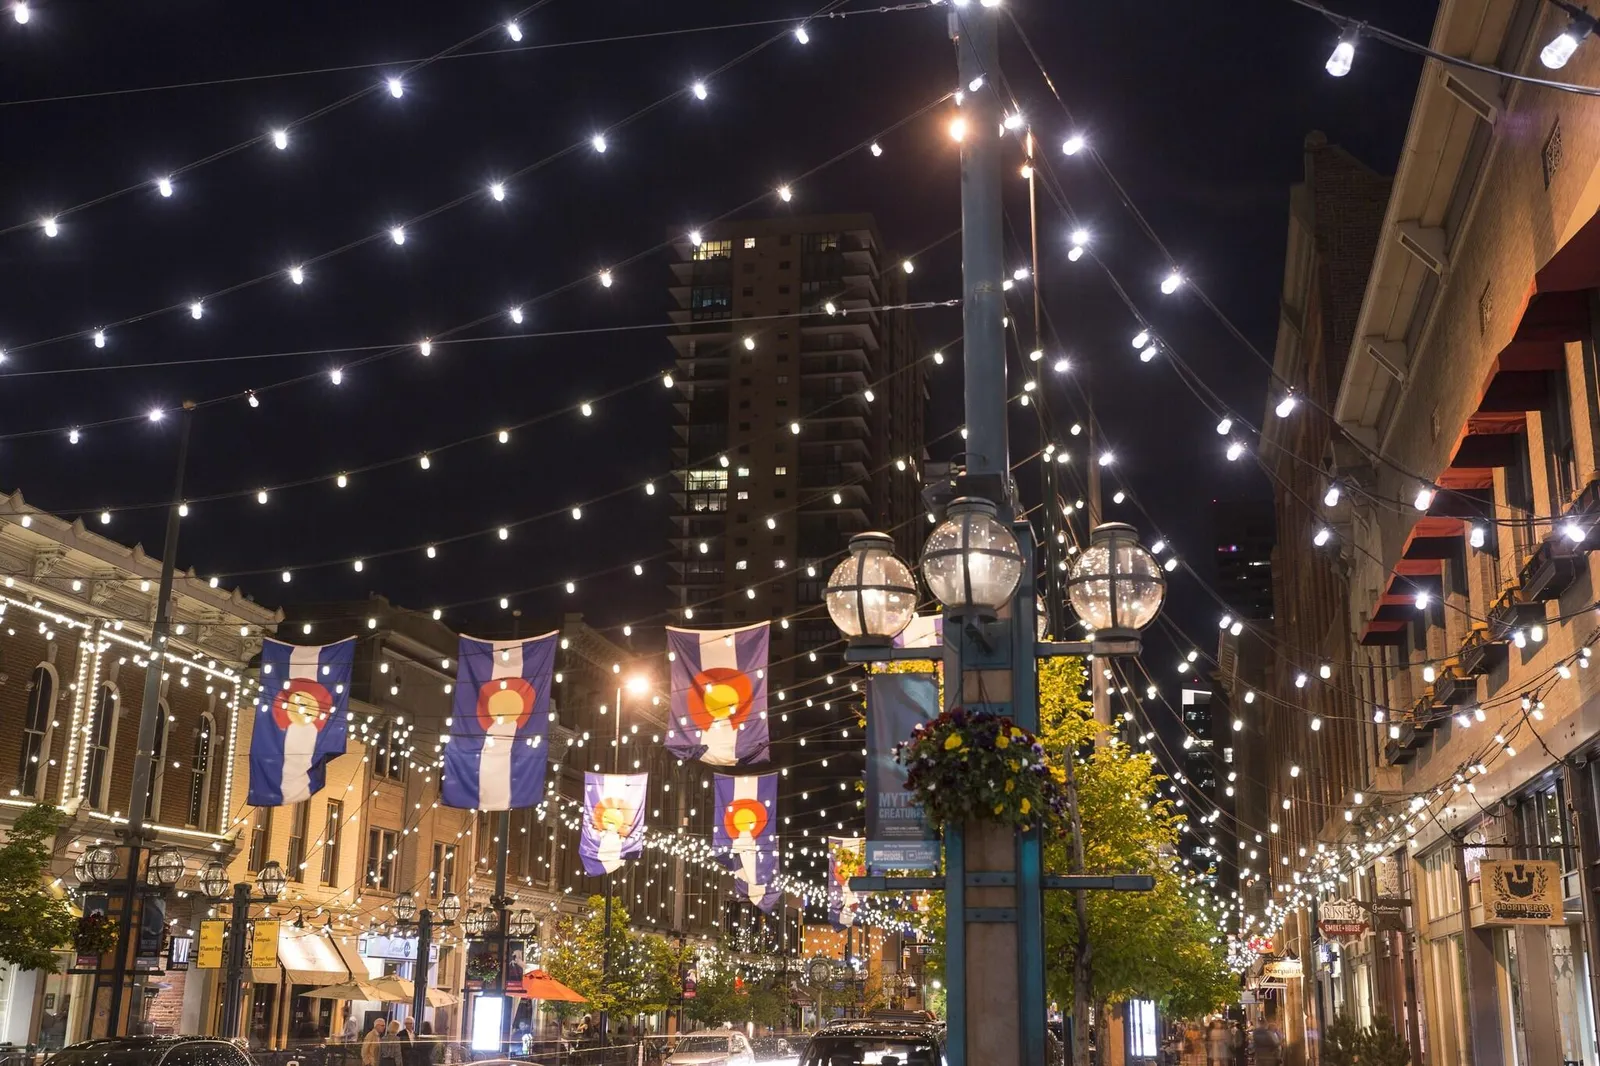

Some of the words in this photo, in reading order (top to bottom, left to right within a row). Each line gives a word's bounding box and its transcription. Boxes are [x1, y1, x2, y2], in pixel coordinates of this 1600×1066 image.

[1494, 901, 1527, 911] GOORIN
[1323, 906, 1361, 920] RUSSE
[1324, 924, 1342, 932] SMOKE
